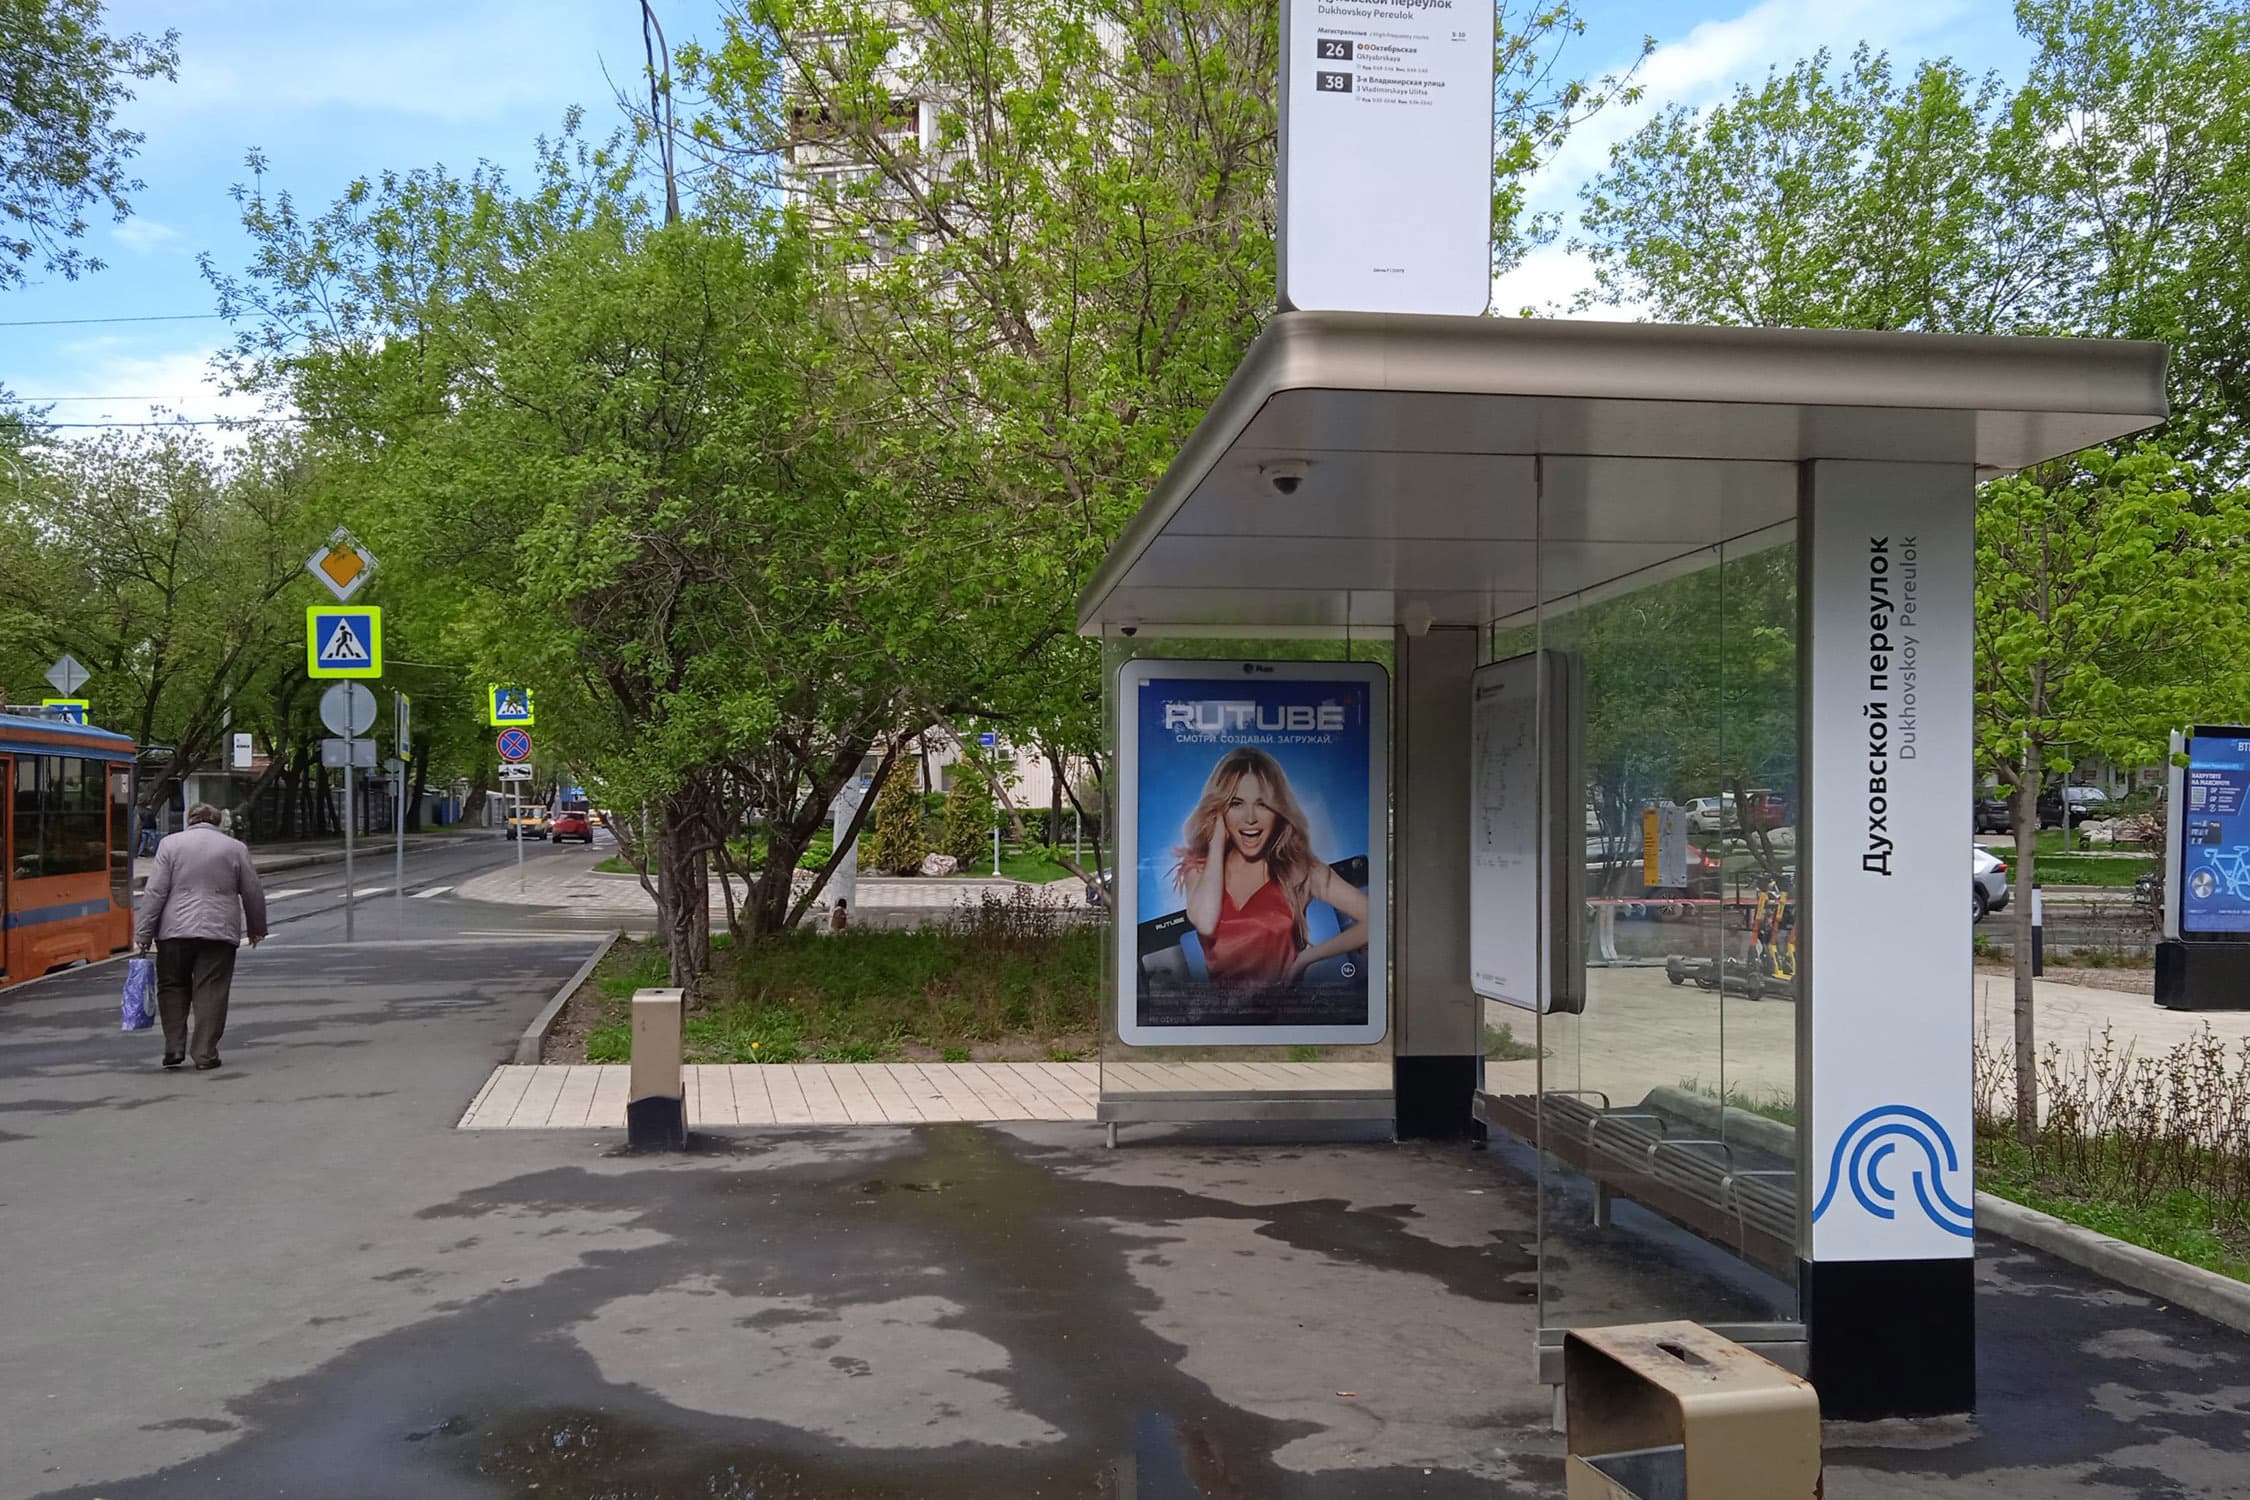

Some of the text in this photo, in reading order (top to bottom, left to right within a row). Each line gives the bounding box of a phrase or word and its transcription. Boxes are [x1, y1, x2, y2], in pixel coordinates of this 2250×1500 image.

[1318, 5, 1413, 20] Dukhovskoy Pereulok
[1326, 43, 1344, 57] 26
[1325, 75, 1344, 89] 38
[1899, 536, 1920, 760] Dukhovskoy Pereulok
[1863, 536, 1894, 876] Духовской переулок
[1165, 704, 1344, 730] RUTUBE
